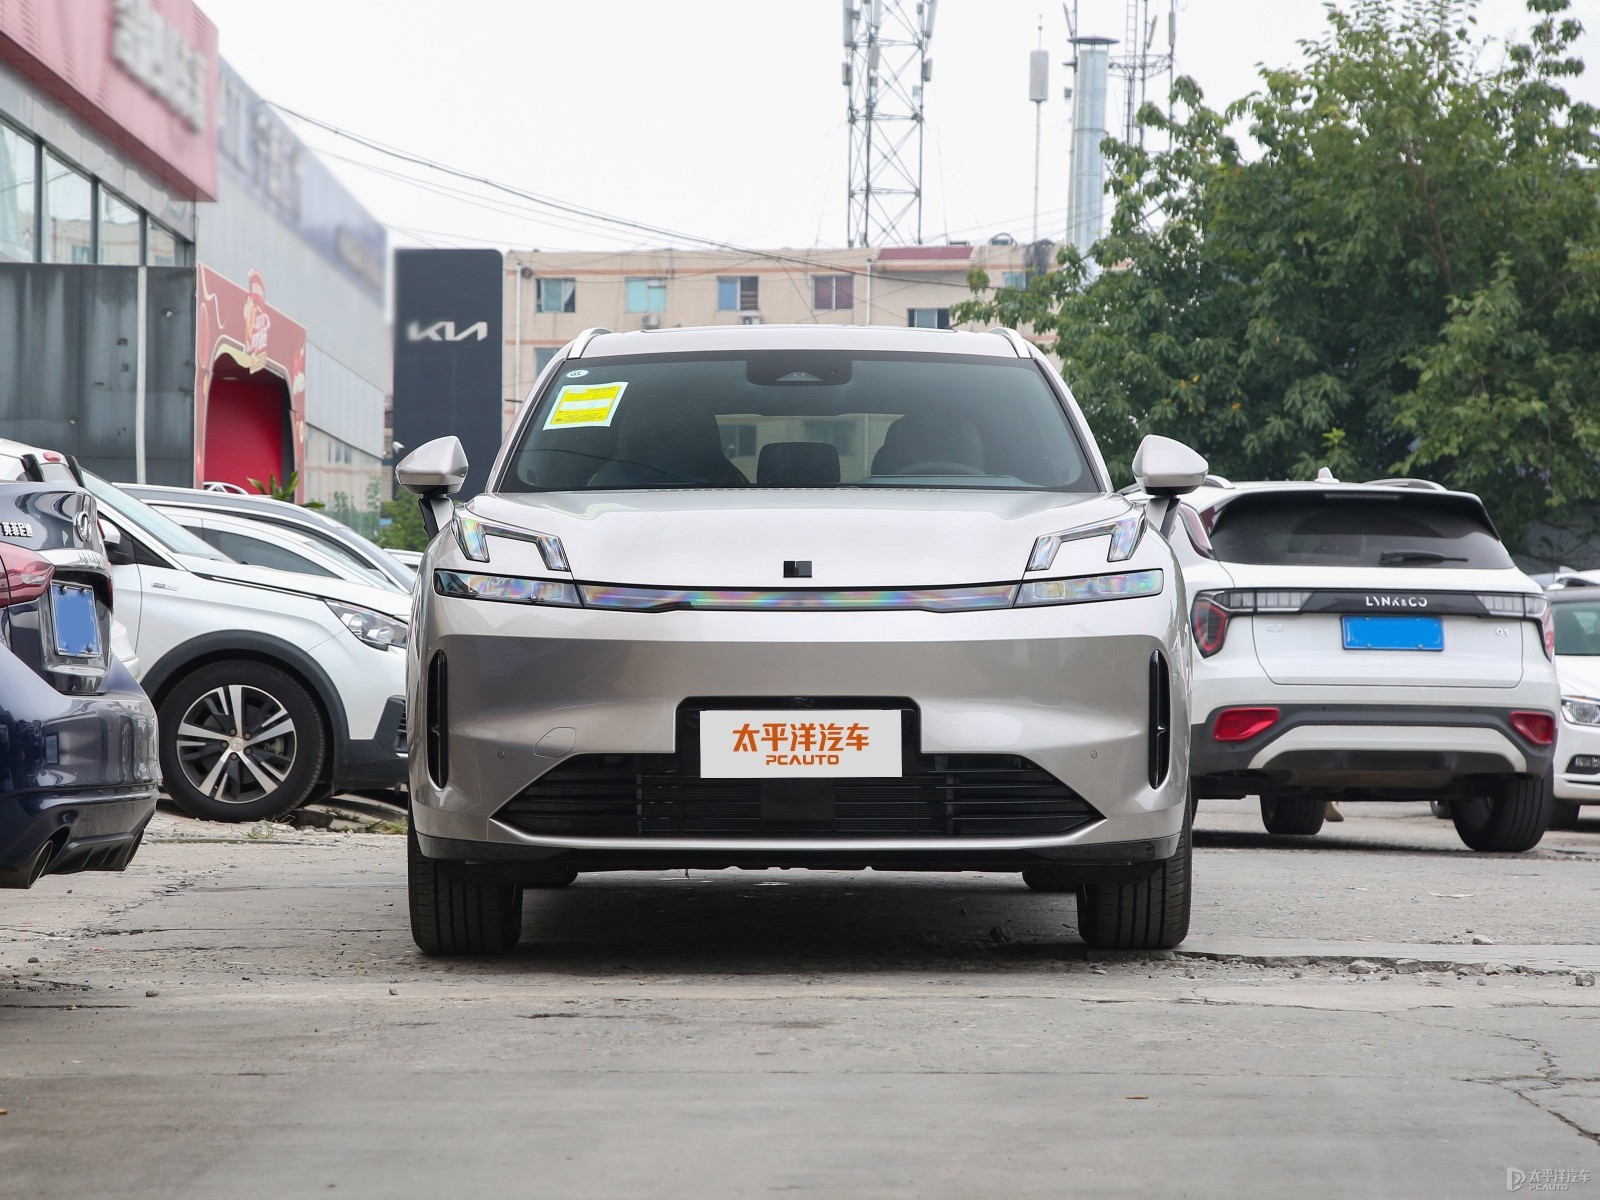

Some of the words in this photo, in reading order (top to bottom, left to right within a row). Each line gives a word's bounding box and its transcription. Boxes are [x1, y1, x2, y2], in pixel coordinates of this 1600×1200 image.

[1365, 595, 1428, 608] LYNK&CO
[732, 722, 870, 752] 太平洋汽车
[766, 754, 840, 766] PCAUTO
